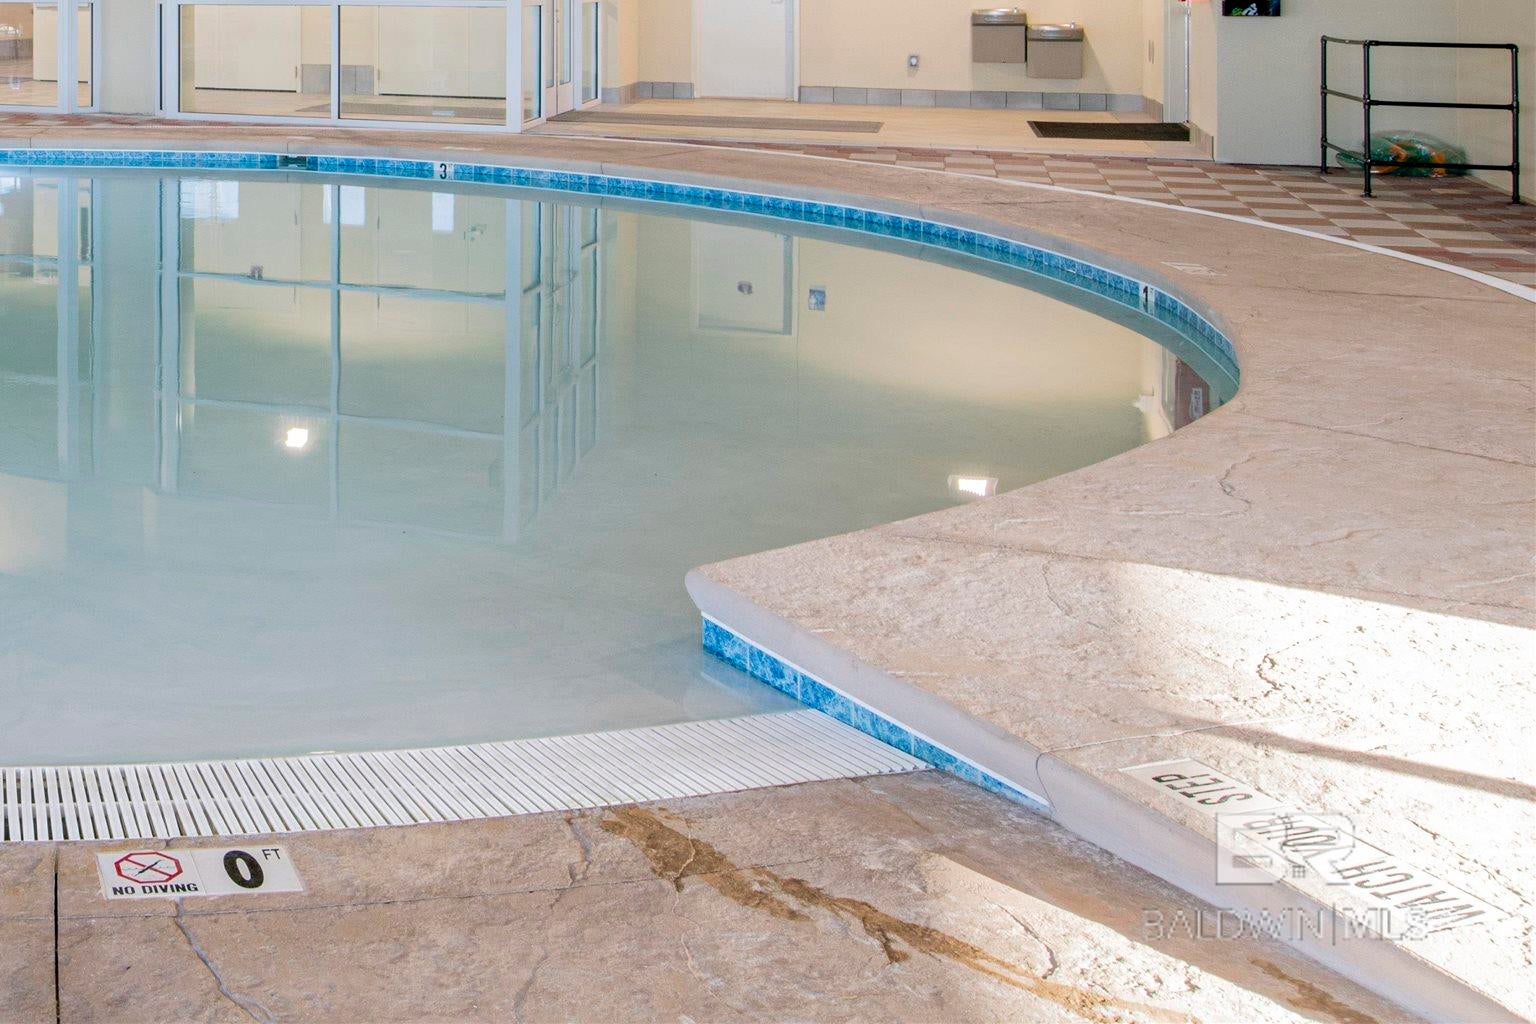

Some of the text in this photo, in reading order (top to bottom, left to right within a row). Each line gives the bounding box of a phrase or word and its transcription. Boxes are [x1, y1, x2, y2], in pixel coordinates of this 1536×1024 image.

[1151, 773, 1253, 806] STEP
[223, 848, 280, 889] 0 FT
[112, 883, 199, 896] NO DIVING
[1342, 860, 1485, 933] WATCH
